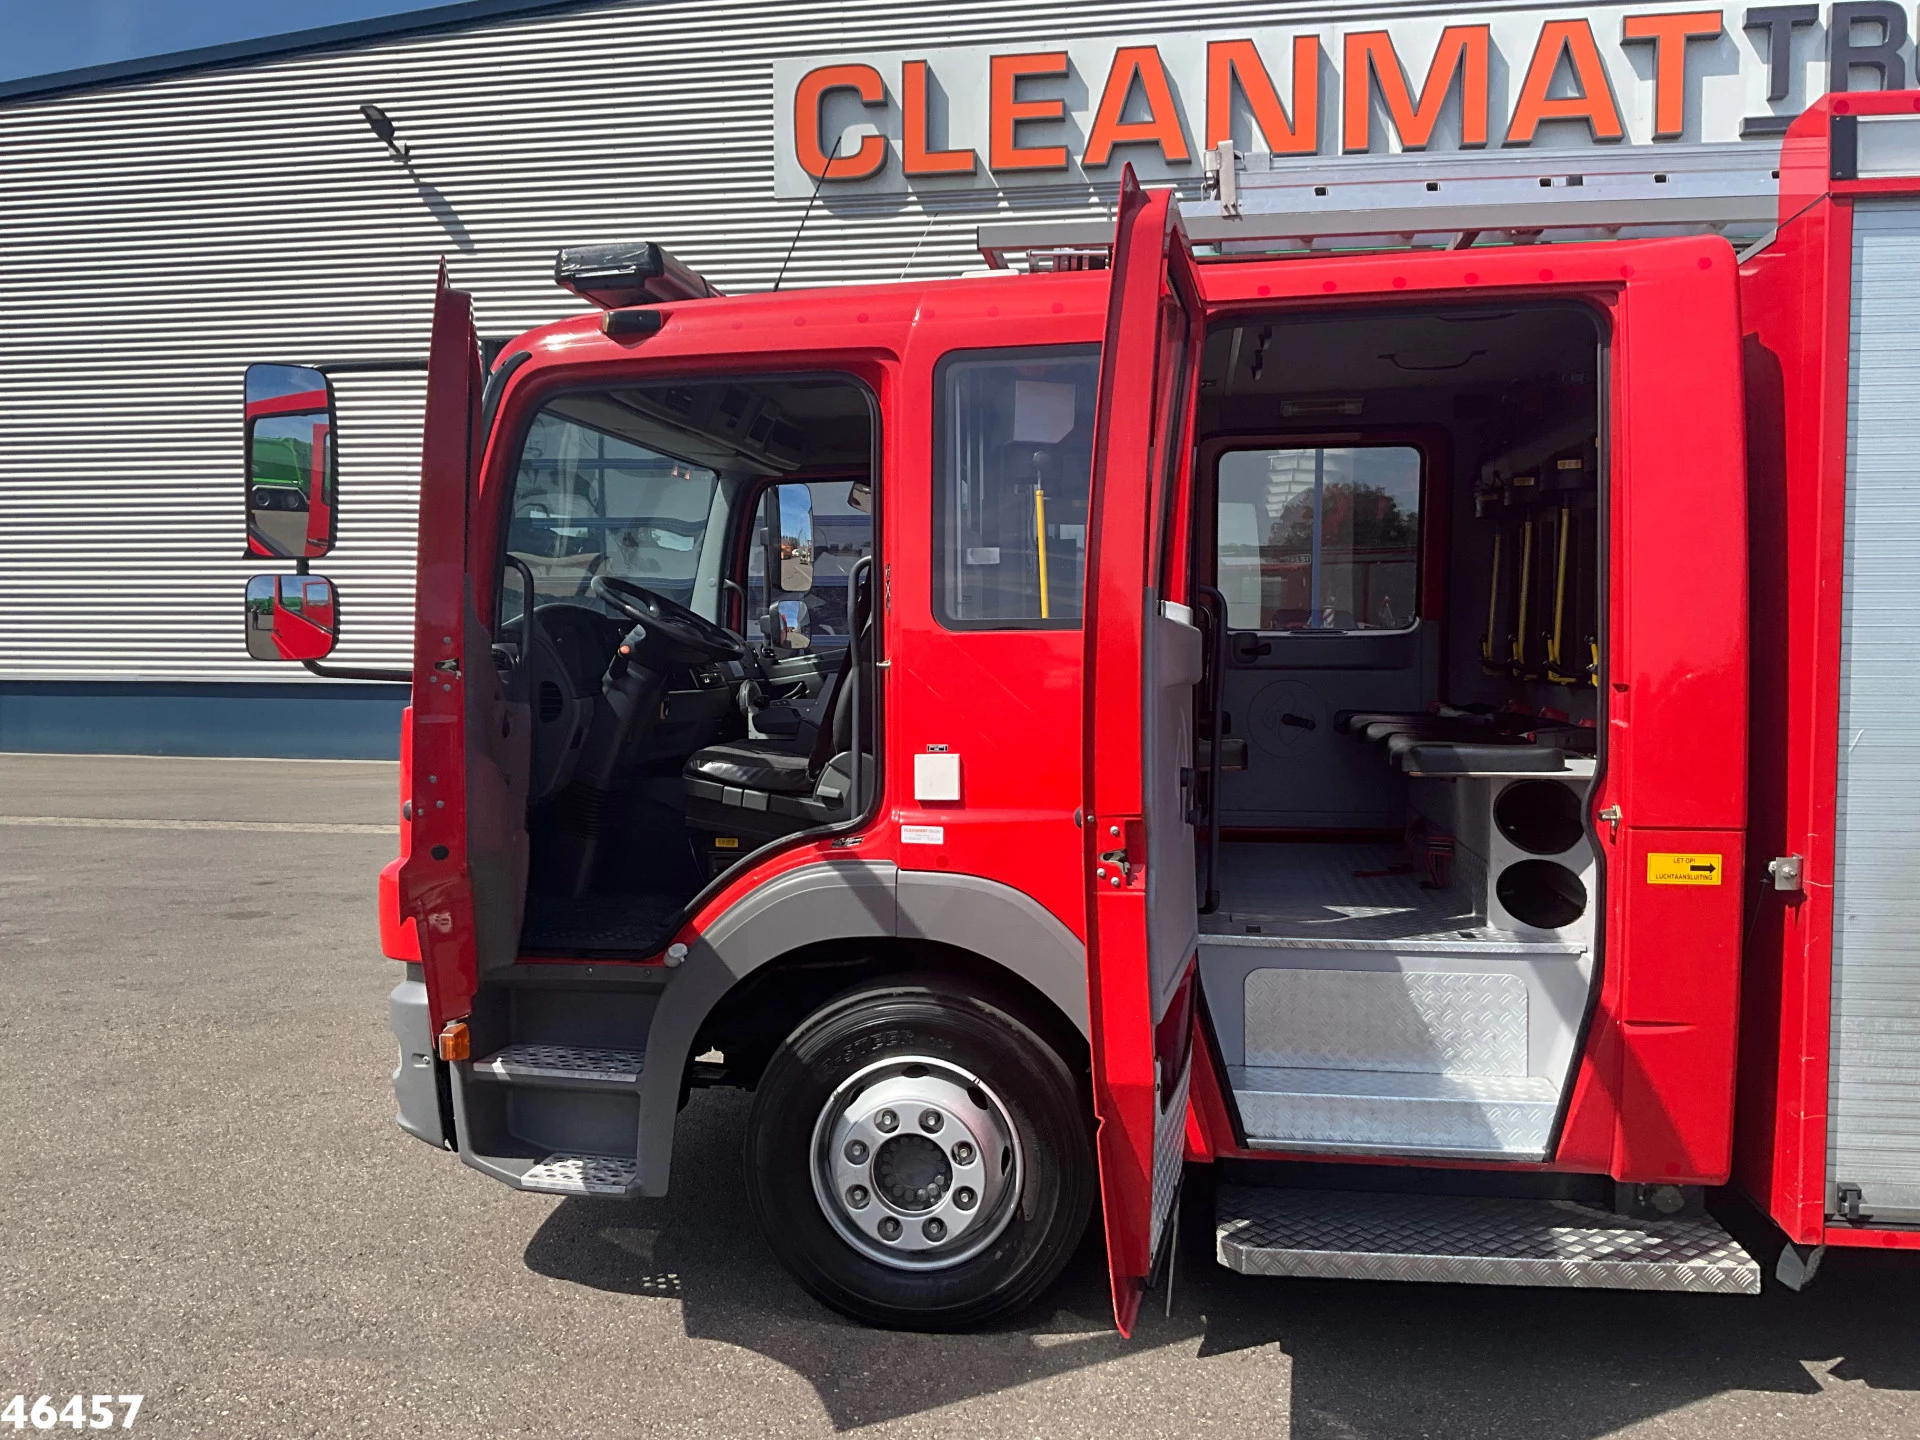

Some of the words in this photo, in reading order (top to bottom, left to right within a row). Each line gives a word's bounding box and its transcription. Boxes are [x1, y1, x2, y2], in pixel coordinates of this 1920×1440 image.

[794, 10, 1723, 182] CLEANMAT
[1742, 1, 1920, 102] TR
[1655, 873, 1713, 881] LUCHTAANSLUITING
